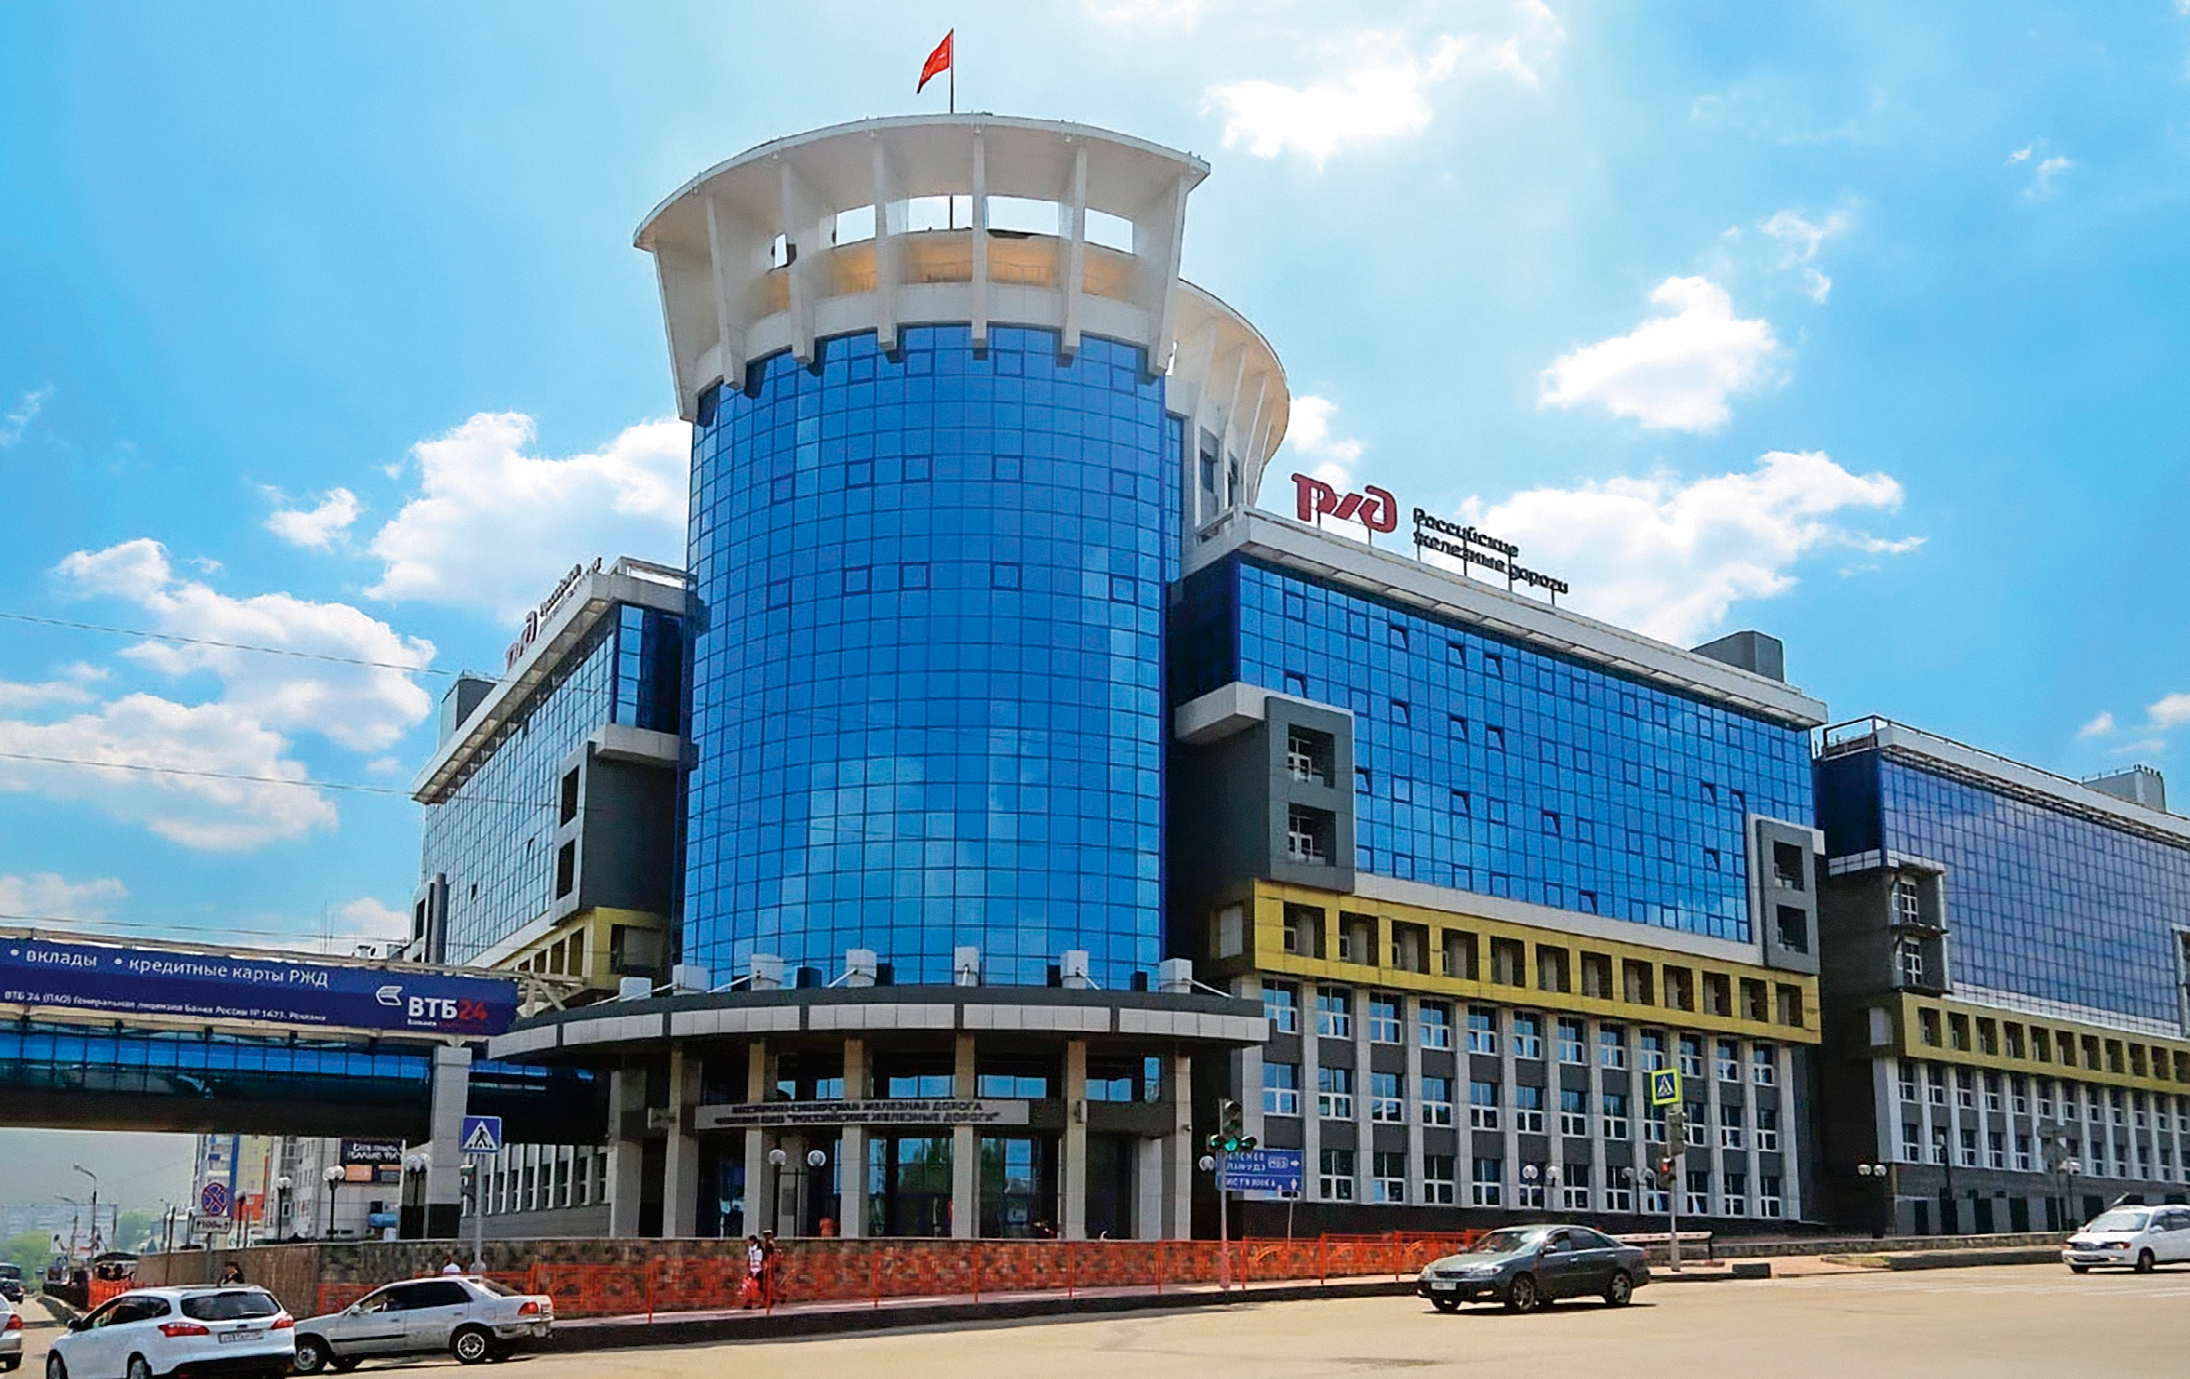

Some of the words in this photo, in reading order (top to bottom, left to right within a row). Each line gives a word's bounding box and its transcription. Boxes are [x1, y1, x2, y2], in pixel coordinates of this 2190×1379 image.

[1291, 473, 1398, 534] РЖД
[1413, 507, 1520, 558] Российские
[1413, 531, 1507, 573] железные
[1509, 563, 1569, 594] дороги
[26, 949, 98, 967] вклады
[129, 957, 228, 979] кредитные
[232, 967, 284, 983] карты
[289, 970, 329, 989] РЖД
[864, 1101, 930, 1111] ЖЕЛЕЗНАЯ
[933, 1101, 983, 1112] ДОРОГА
